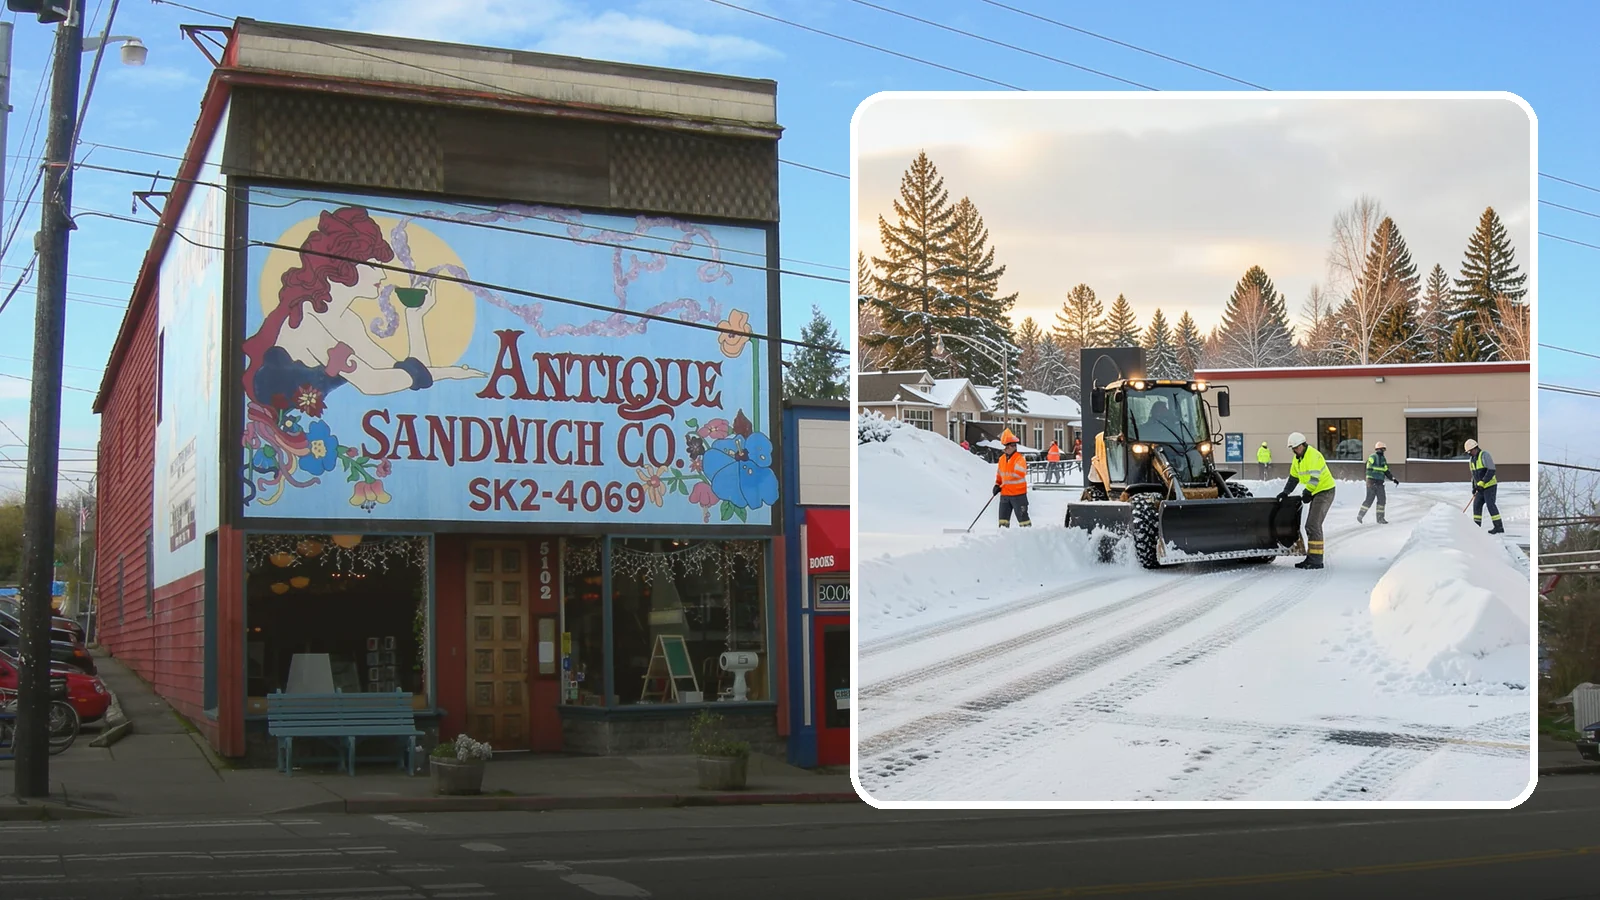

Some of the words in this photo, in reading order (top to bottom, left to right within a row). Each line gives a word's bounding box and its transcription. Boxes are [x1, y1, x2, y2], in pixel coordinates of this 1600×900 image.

[476, 329, 724, 421] ANTIQUE
[362, 408, 604, 467] SANDWICH
[617, 421, 686, 470] CO.
[469, 478, 646, 513] SK2-4069
[539, 541, 552, 600] 5102
[809, 555, 835, 569] BOOKS
